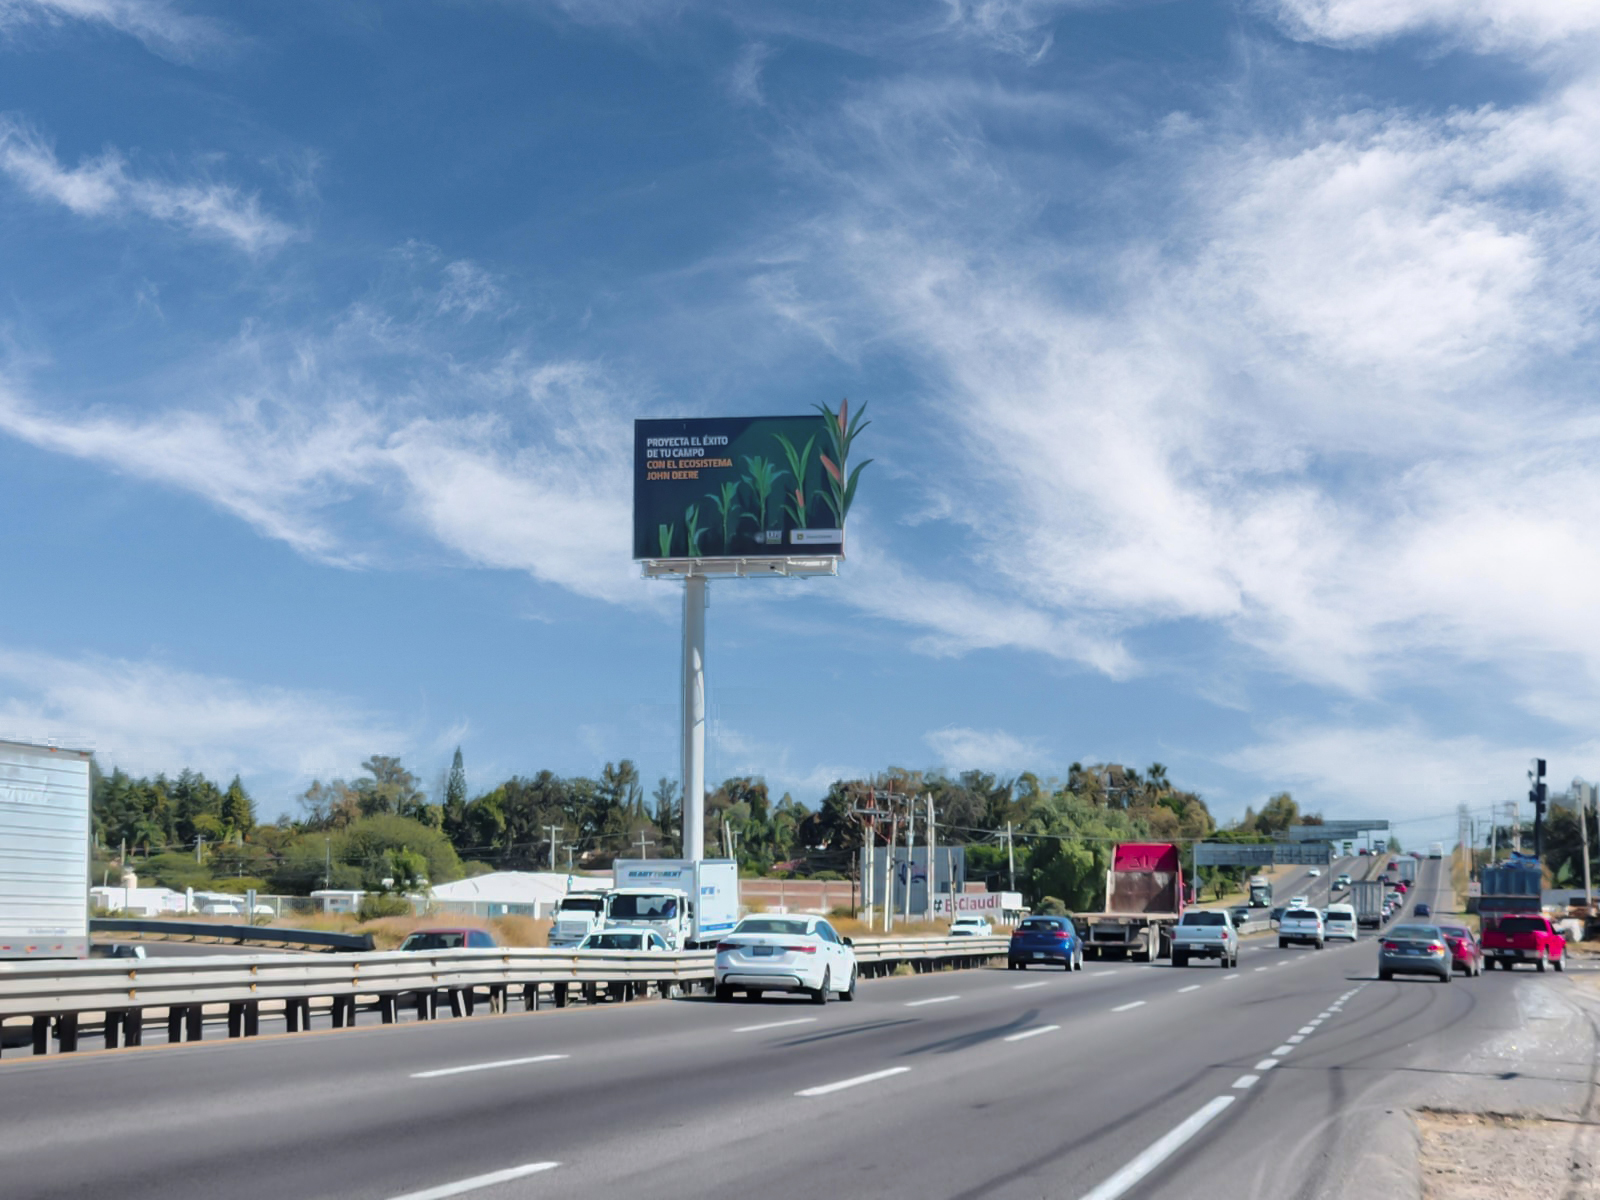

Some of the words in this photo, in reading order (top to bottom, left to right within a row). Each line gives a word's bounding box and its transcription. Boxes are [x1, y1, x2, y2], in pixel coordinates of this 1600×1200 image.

[647, 437, 690, 447] PROYECTA
[691, 437, 702, 446] EL
[703, 434, 728, 446] ÉXITO
[647, 449, 658, 458] DE
[660, 448, 671, 457] TU
[672, 447, 704, 457] CAMPO
[647, 460, 665, 469] CON
[667, 460, 677, 469] EL
[679, 458, 733, 469] ECOSISTEMA
[647, 471, 670, 480] JOHN
[672, 470, 699, 480] DEERE
